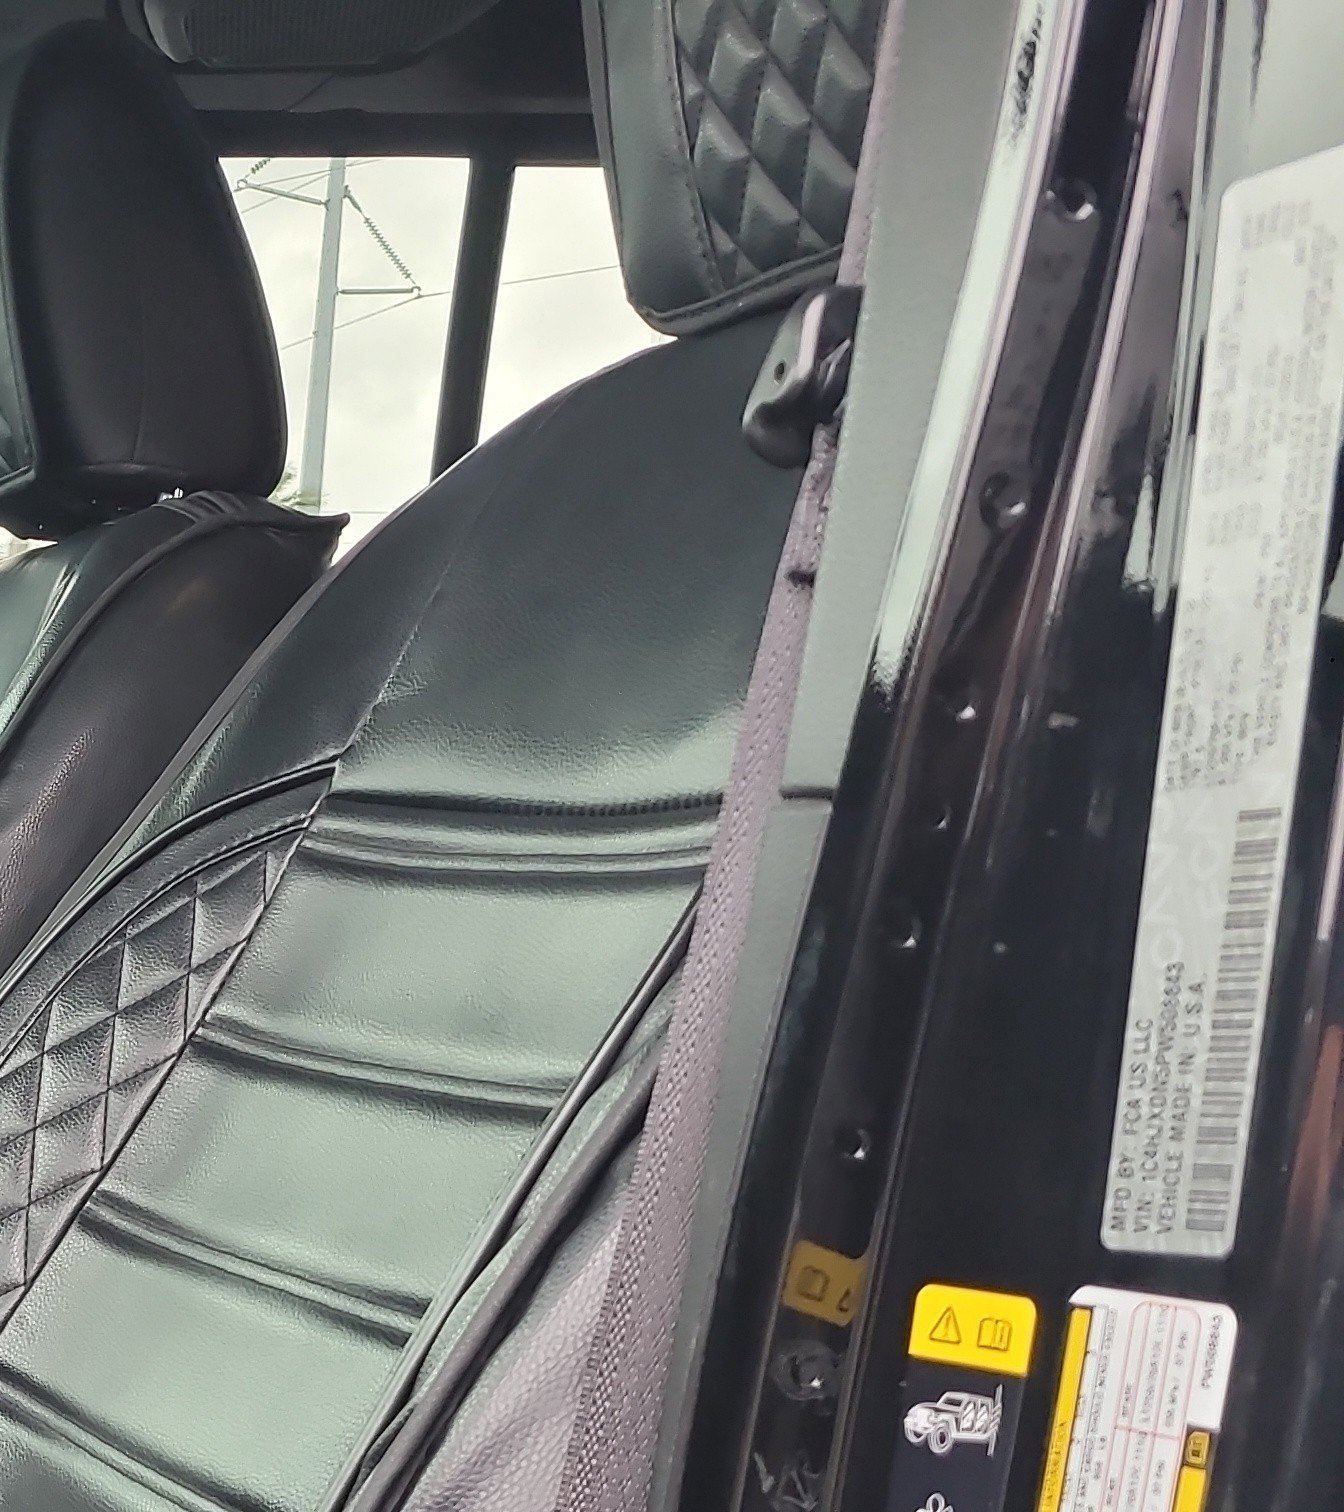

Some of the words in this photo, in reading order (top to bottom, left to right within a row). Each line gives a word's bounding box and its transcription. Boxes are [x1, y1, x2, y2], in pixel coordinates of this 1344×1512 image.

[1132, 1018, 1154, 1054] LLC
[1130, 1061, 1148, 1090] US
[1123, 1098, 1142, 1136] FCA
[1168, 1082, 1192, 1143] MADE
[1156, 1150, 1184, 1234] VEHICLE
